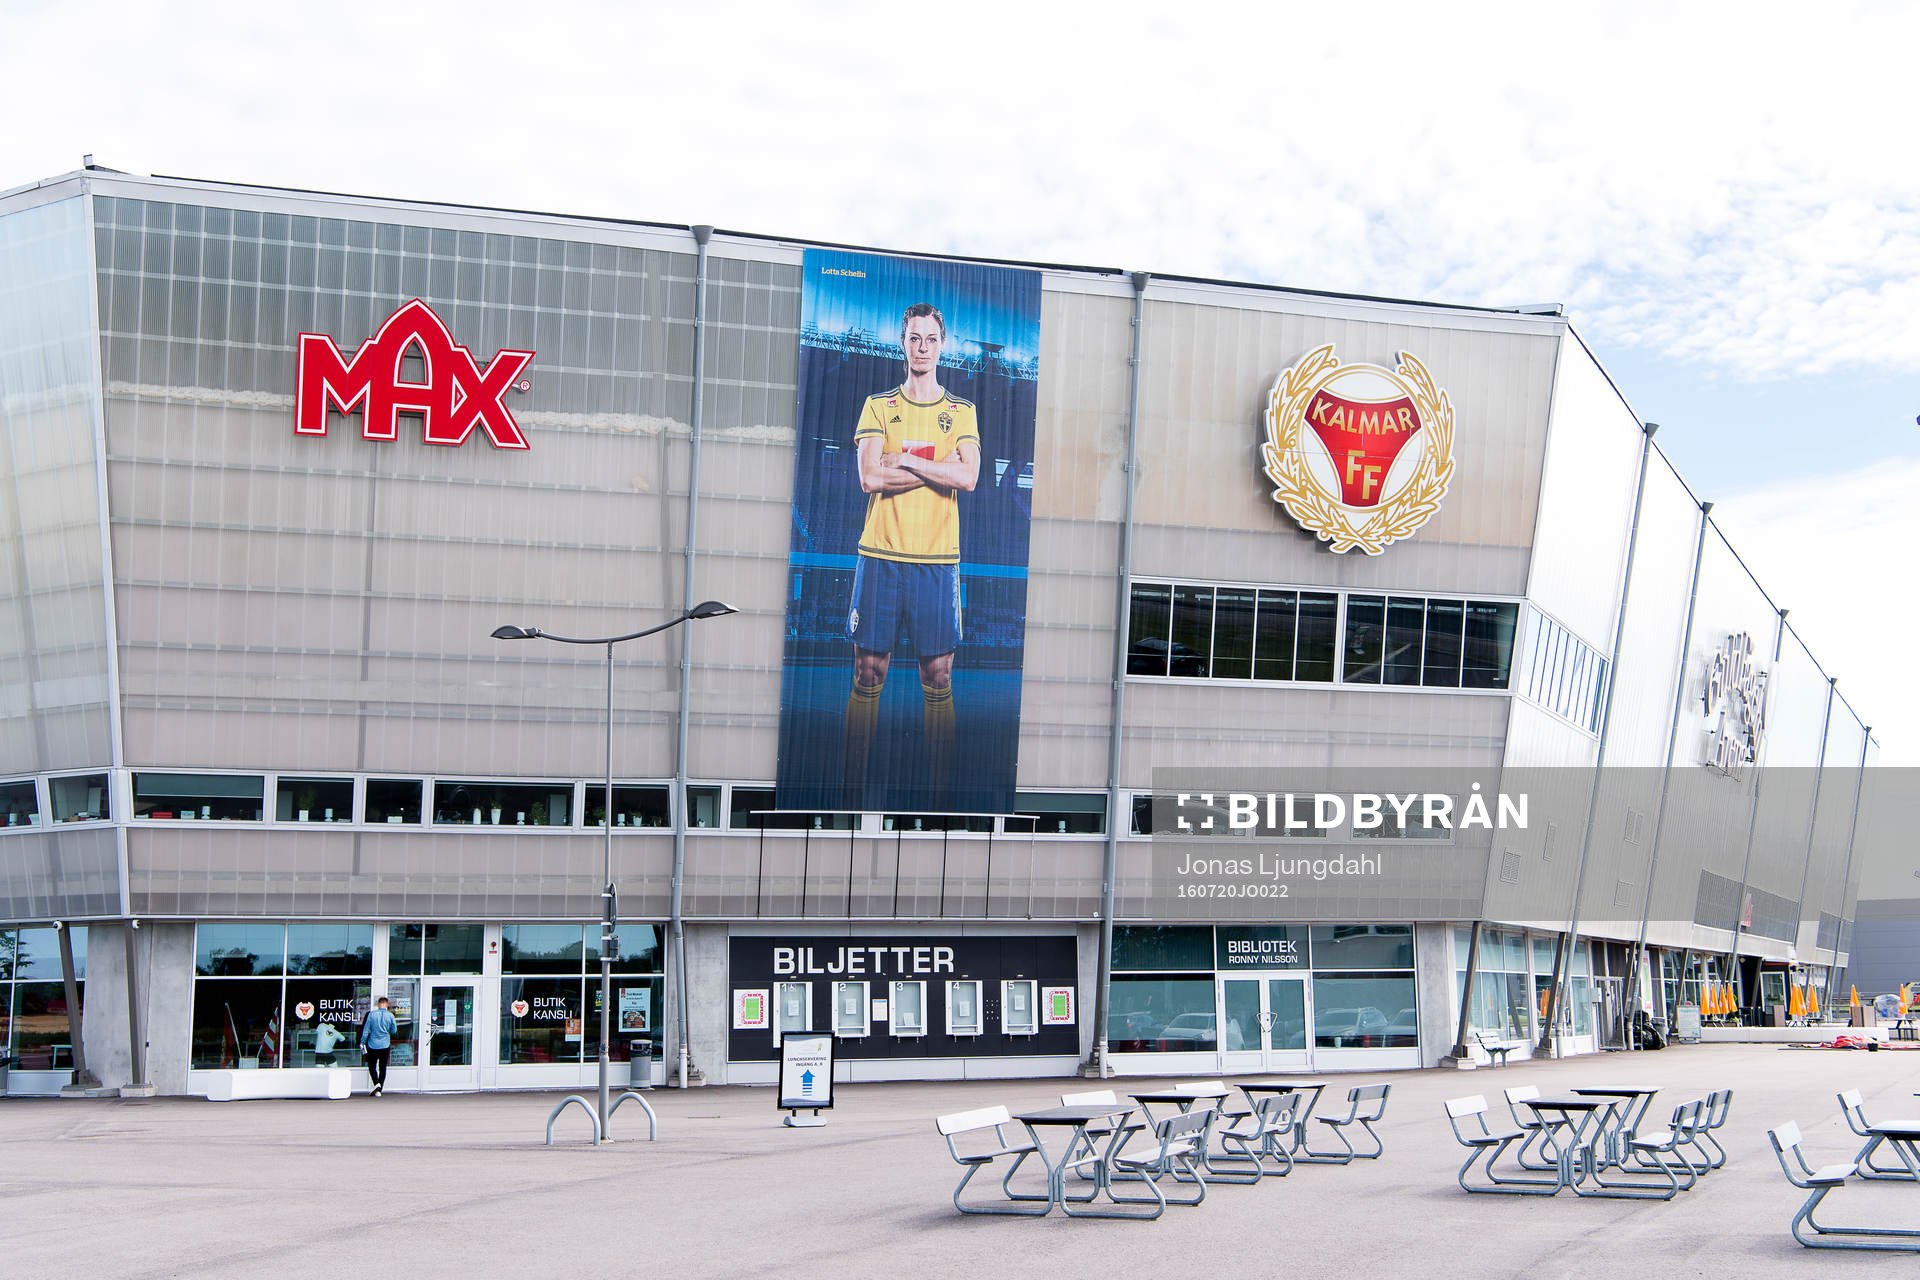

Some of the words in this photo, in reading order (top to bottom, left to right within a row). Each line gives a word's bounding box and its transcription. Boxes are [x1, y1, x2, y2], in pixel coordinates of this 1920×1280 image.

[821, 267, 839, 275] Lotta
[840, 269, 866, 278] Schelin
[295, 297, 536, 450] MAX
[1311, 398, 1415, 435] KALMAR
[1228, 940, 1297, 953] BIBLIOTEK
[774, 947, 954, 974] BILJETTER
[1229, 955, 1259, 964] RONNY
[1261, 955, 1298, 963] NILSSON
[782, 983, 788, 992] 1
[839, 983, 847, 992] 2
[896, 983, 904, 992] 3
[953, 982, 961, 991] 4
[1007, 981, 1015, 990] 5
[319, 999, 354, 1009] BUTIK
[533, 997, 566, 1007] BUTIK
[319, 1012, 361, 1022] KANSLI
[533, 1010, 573, 1020] KANSLI
